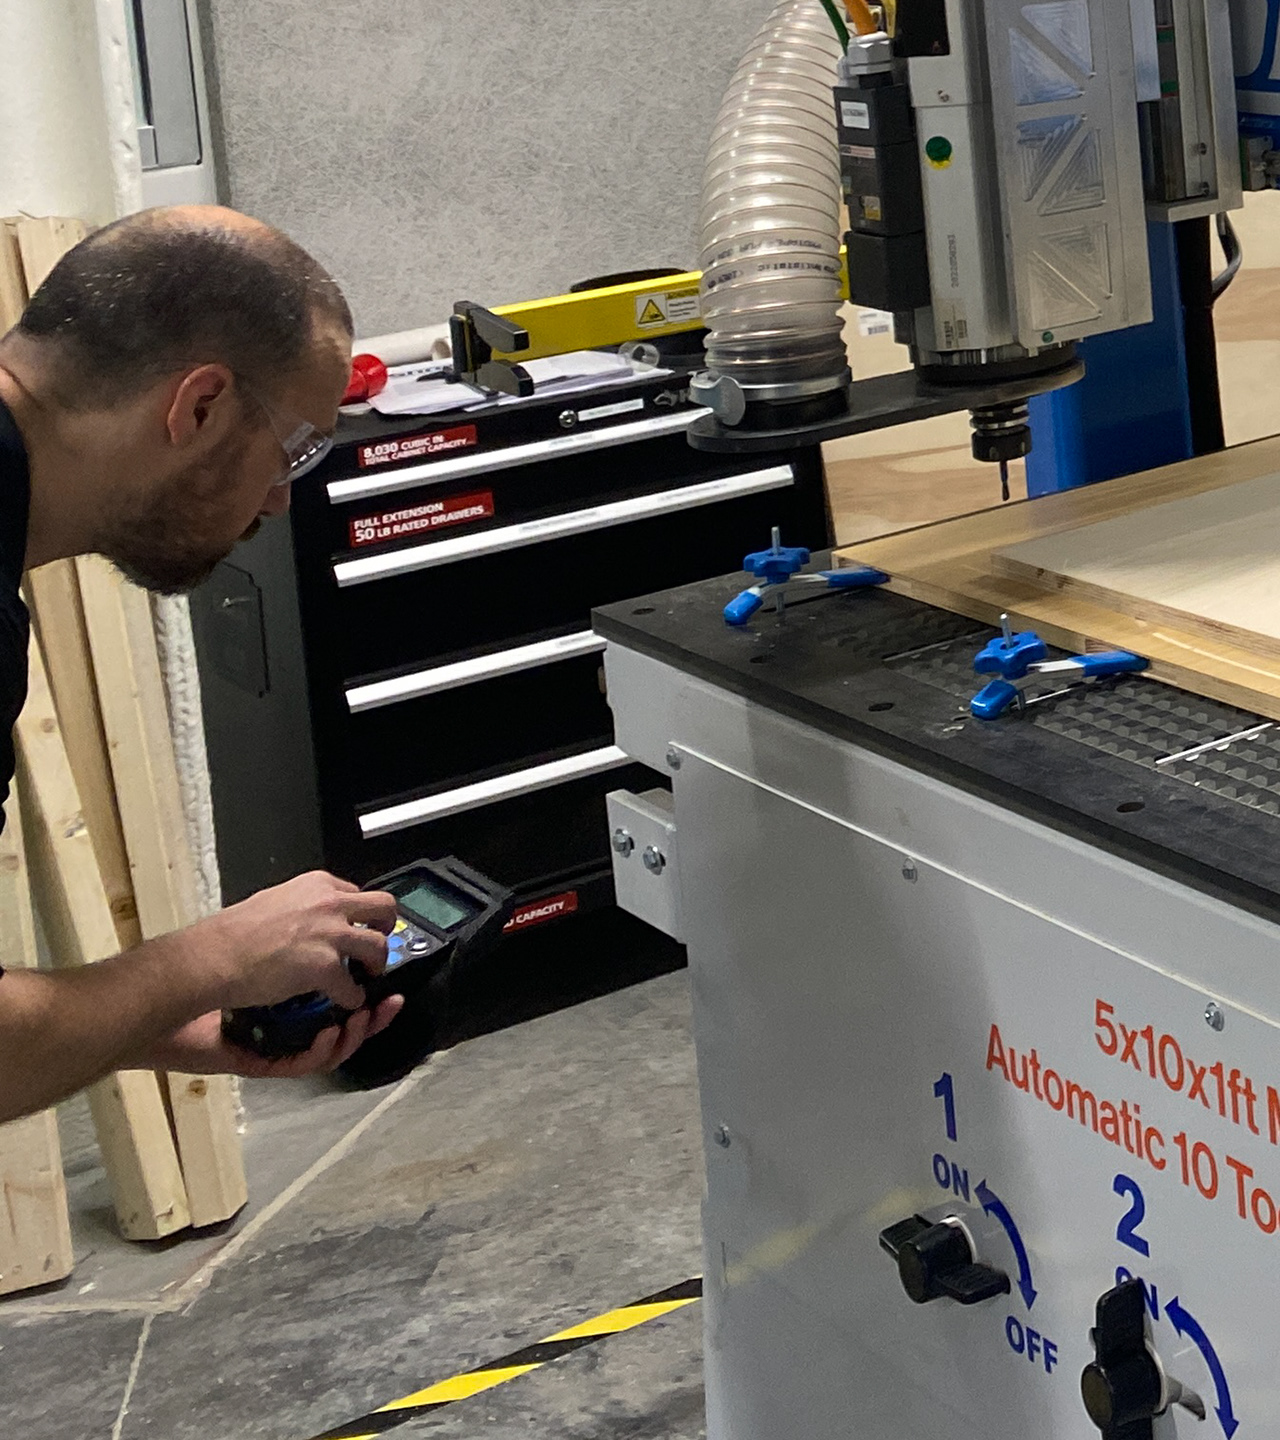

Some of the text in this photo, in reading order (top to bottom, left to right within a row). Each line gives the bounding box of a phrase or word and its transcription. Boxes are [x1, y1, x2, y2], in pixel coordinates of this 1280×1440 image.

[363, 434, 445, 459] 8,030 CUBIC IN
[427, 438, 467, 453] CAPACITY
[354, 503, 444, 530] FULL EXTENSION
[355, 505, 484, 542] 50 LB RATED DRAWERS
[516, 901, 565, 924] CAPACITY
[1094, 999, 1259, 1137] 5x10x1ft
[933, 1072, 958, 1142] 1
[986, 1023, 1167, 1172] Automatic
[1173, 1131, 1219, 1201] 10
[933, 1154, 970, 1205] ON
[1113, 1174, 1150, 1258] 2
[1005, 1315, 1058, 1375] OFF
